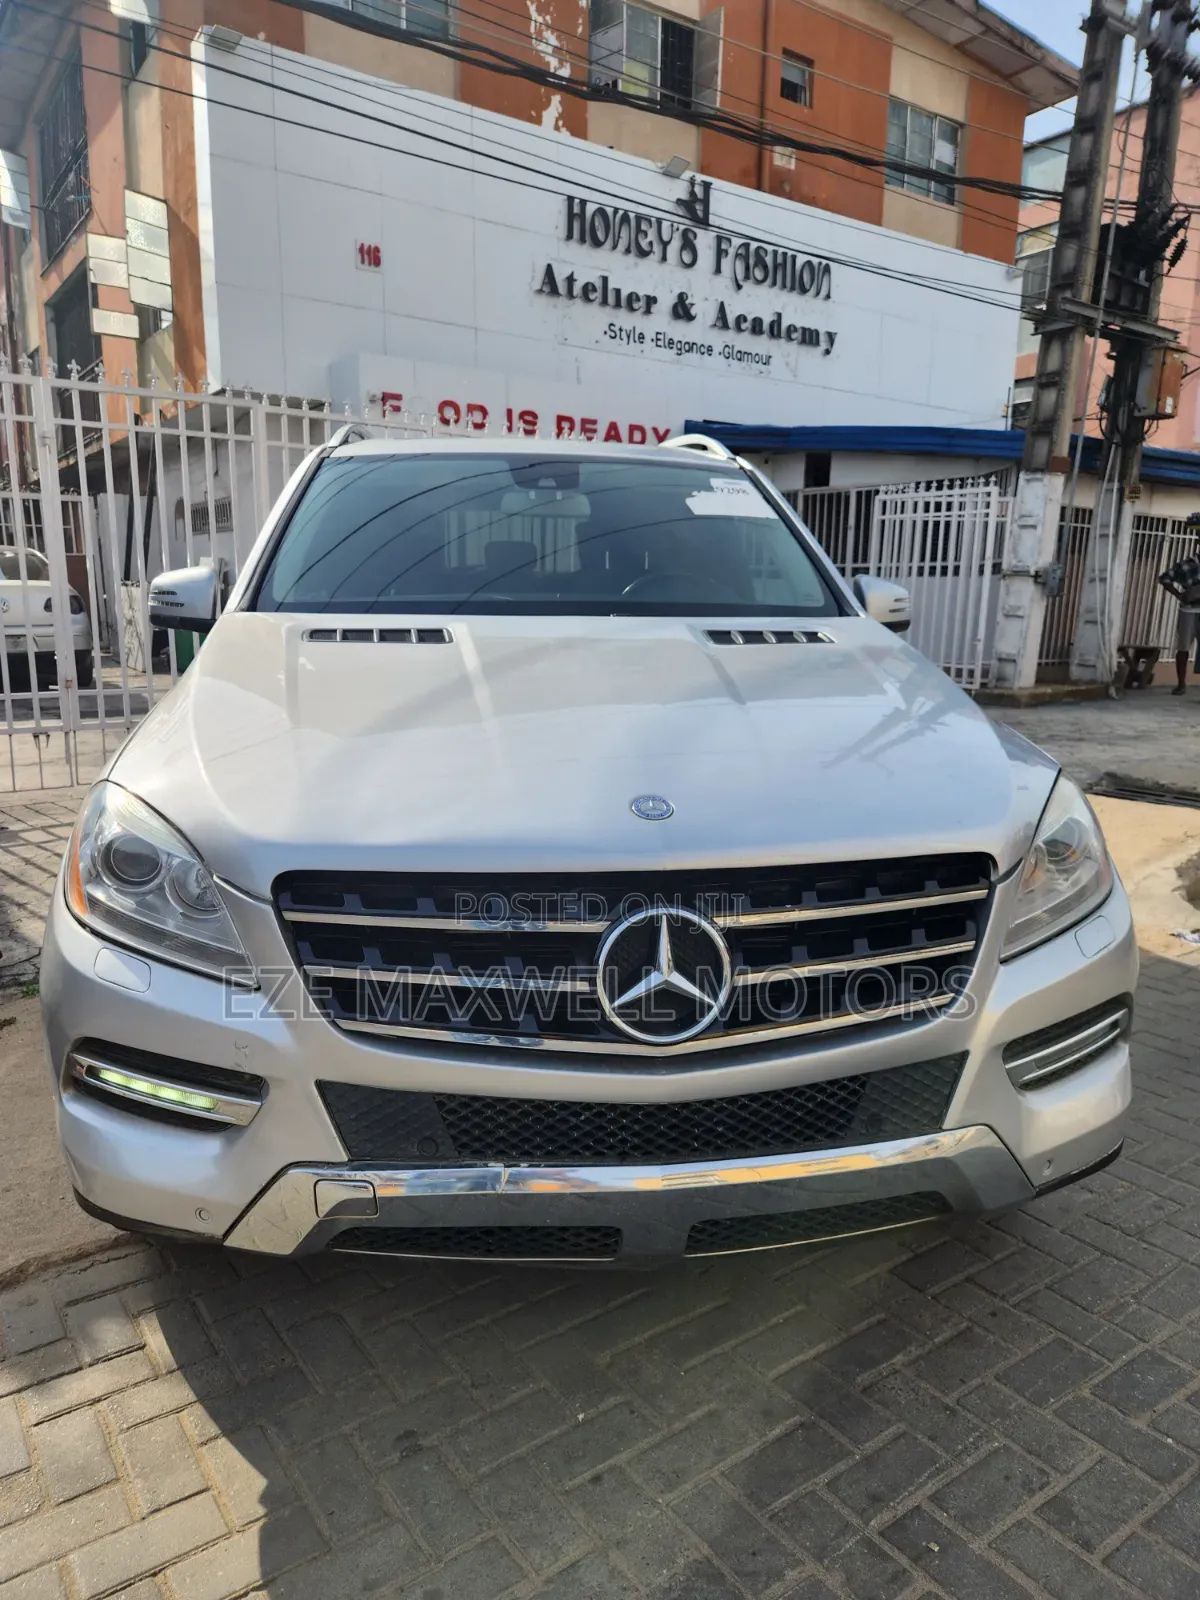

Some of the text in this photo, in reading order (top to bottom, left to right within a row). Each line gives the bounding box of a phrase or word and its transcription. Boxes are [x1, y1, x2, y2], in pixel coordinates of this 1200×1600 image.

[359, 242, 382, 268] 116
[565, 194, 698, 269] HONEY'S
[713, 233, 832, 301] FASHION
[672, 290, 698, 322] &
[710, 300, 838, 356] Academy
[506, 407, 539, 436] IS
